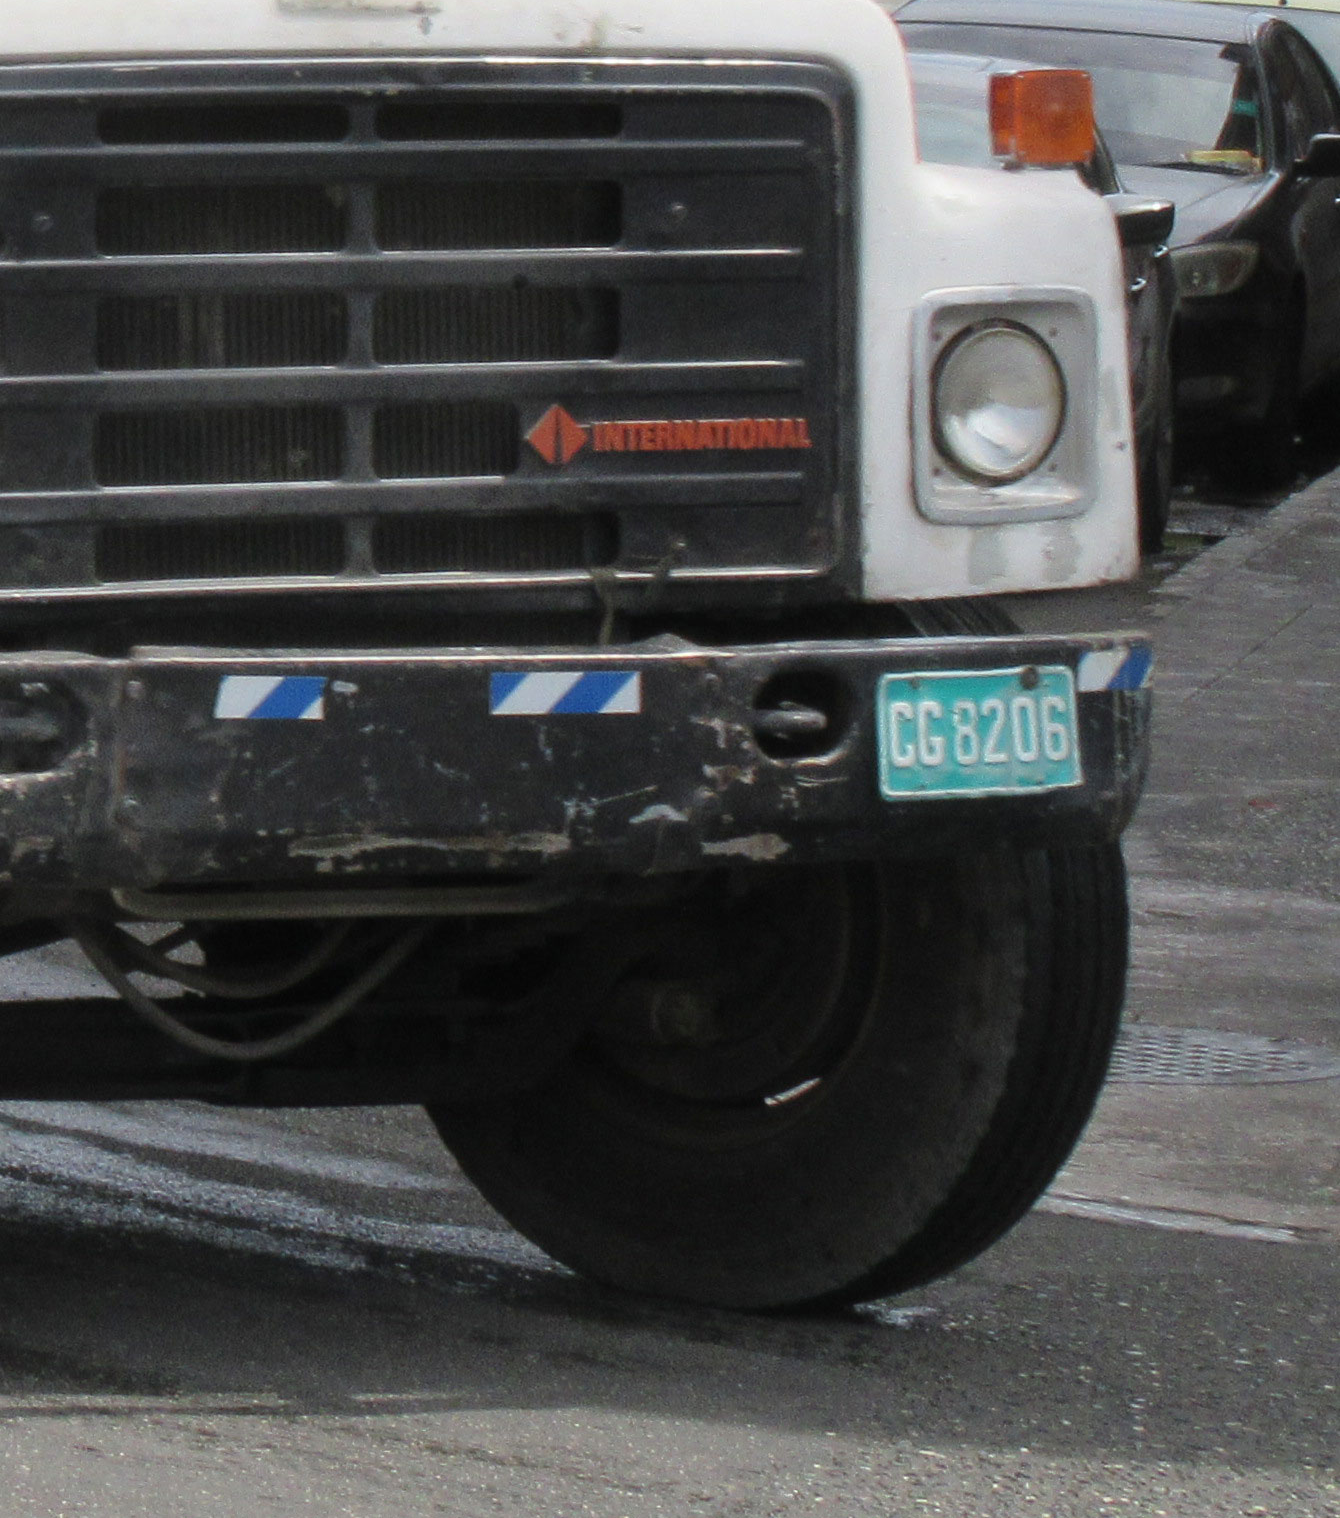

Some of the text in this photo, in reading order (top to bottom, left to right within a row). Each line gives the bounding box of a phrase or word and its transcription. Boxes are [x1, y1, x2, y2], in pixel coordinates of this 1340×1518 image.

[592, 418, 812, 451] INTERNATIONAL
[890, 695, 1070, 768] CG 8206
